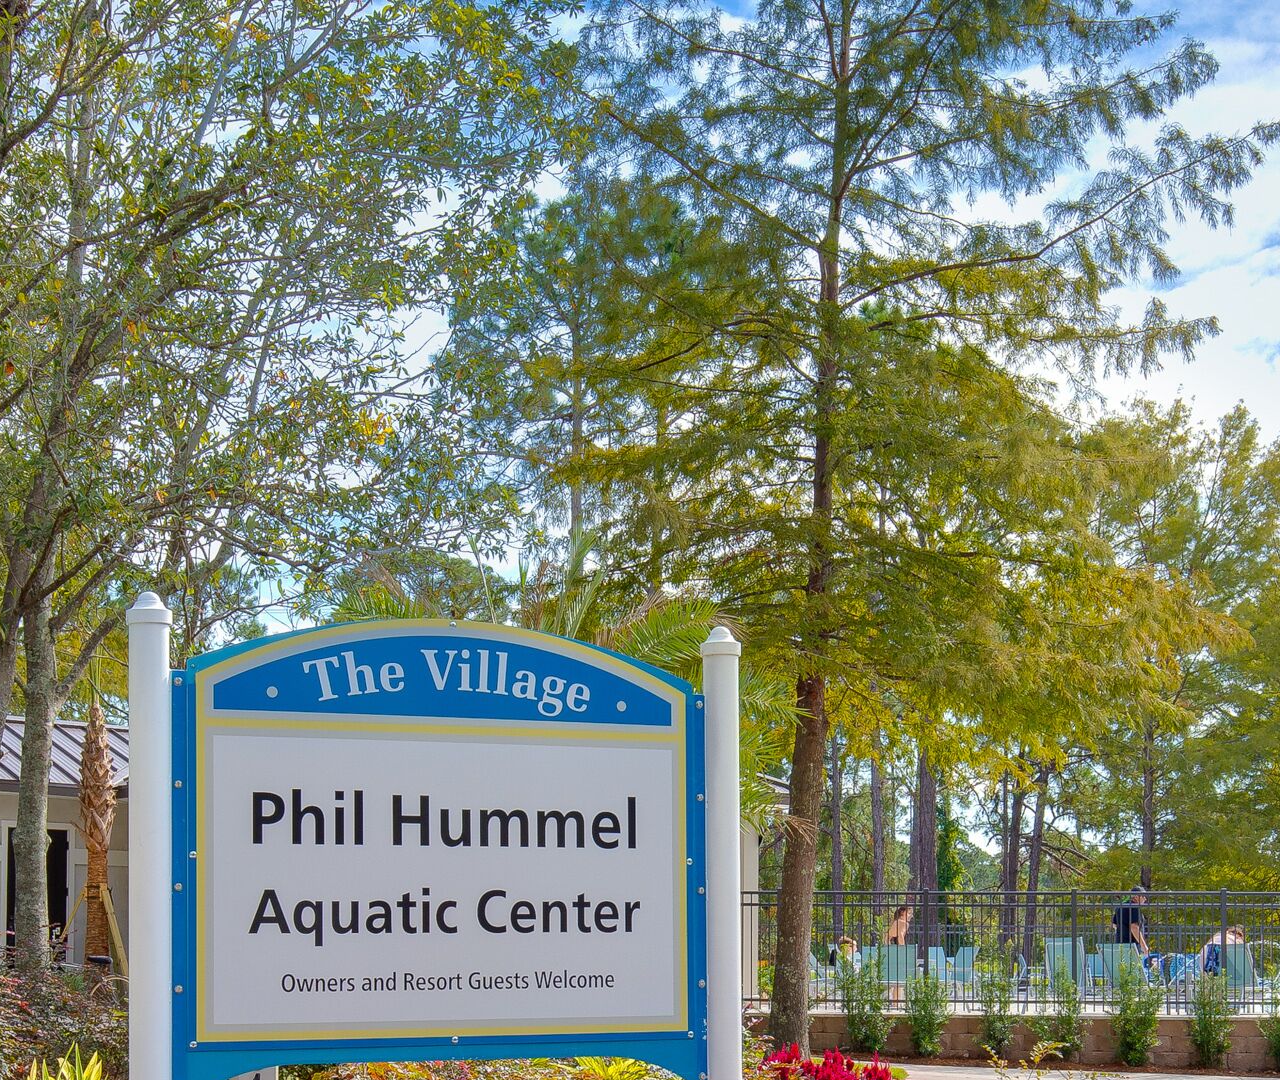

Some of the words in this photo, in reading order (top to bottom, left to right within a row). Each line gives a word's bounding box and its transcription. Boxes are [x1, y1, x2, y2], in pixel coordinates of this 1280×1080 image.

[302, 650, 405, 702] The
[420, 648, 592, 718] Village
[251, 788, 365, 847] Phil
[391, 795, 638, 850] Hummel
[248, 887, 459, 948] Aquatic
[475, 889, 642, 936] Center
[280, 973, 357, 994] Owners
[361, 971, 398, 993] and
[402, 972, 464, 992] Resort
[467, 971, 531, 991] Guests
[534, 969, 616, 990] Welcome
